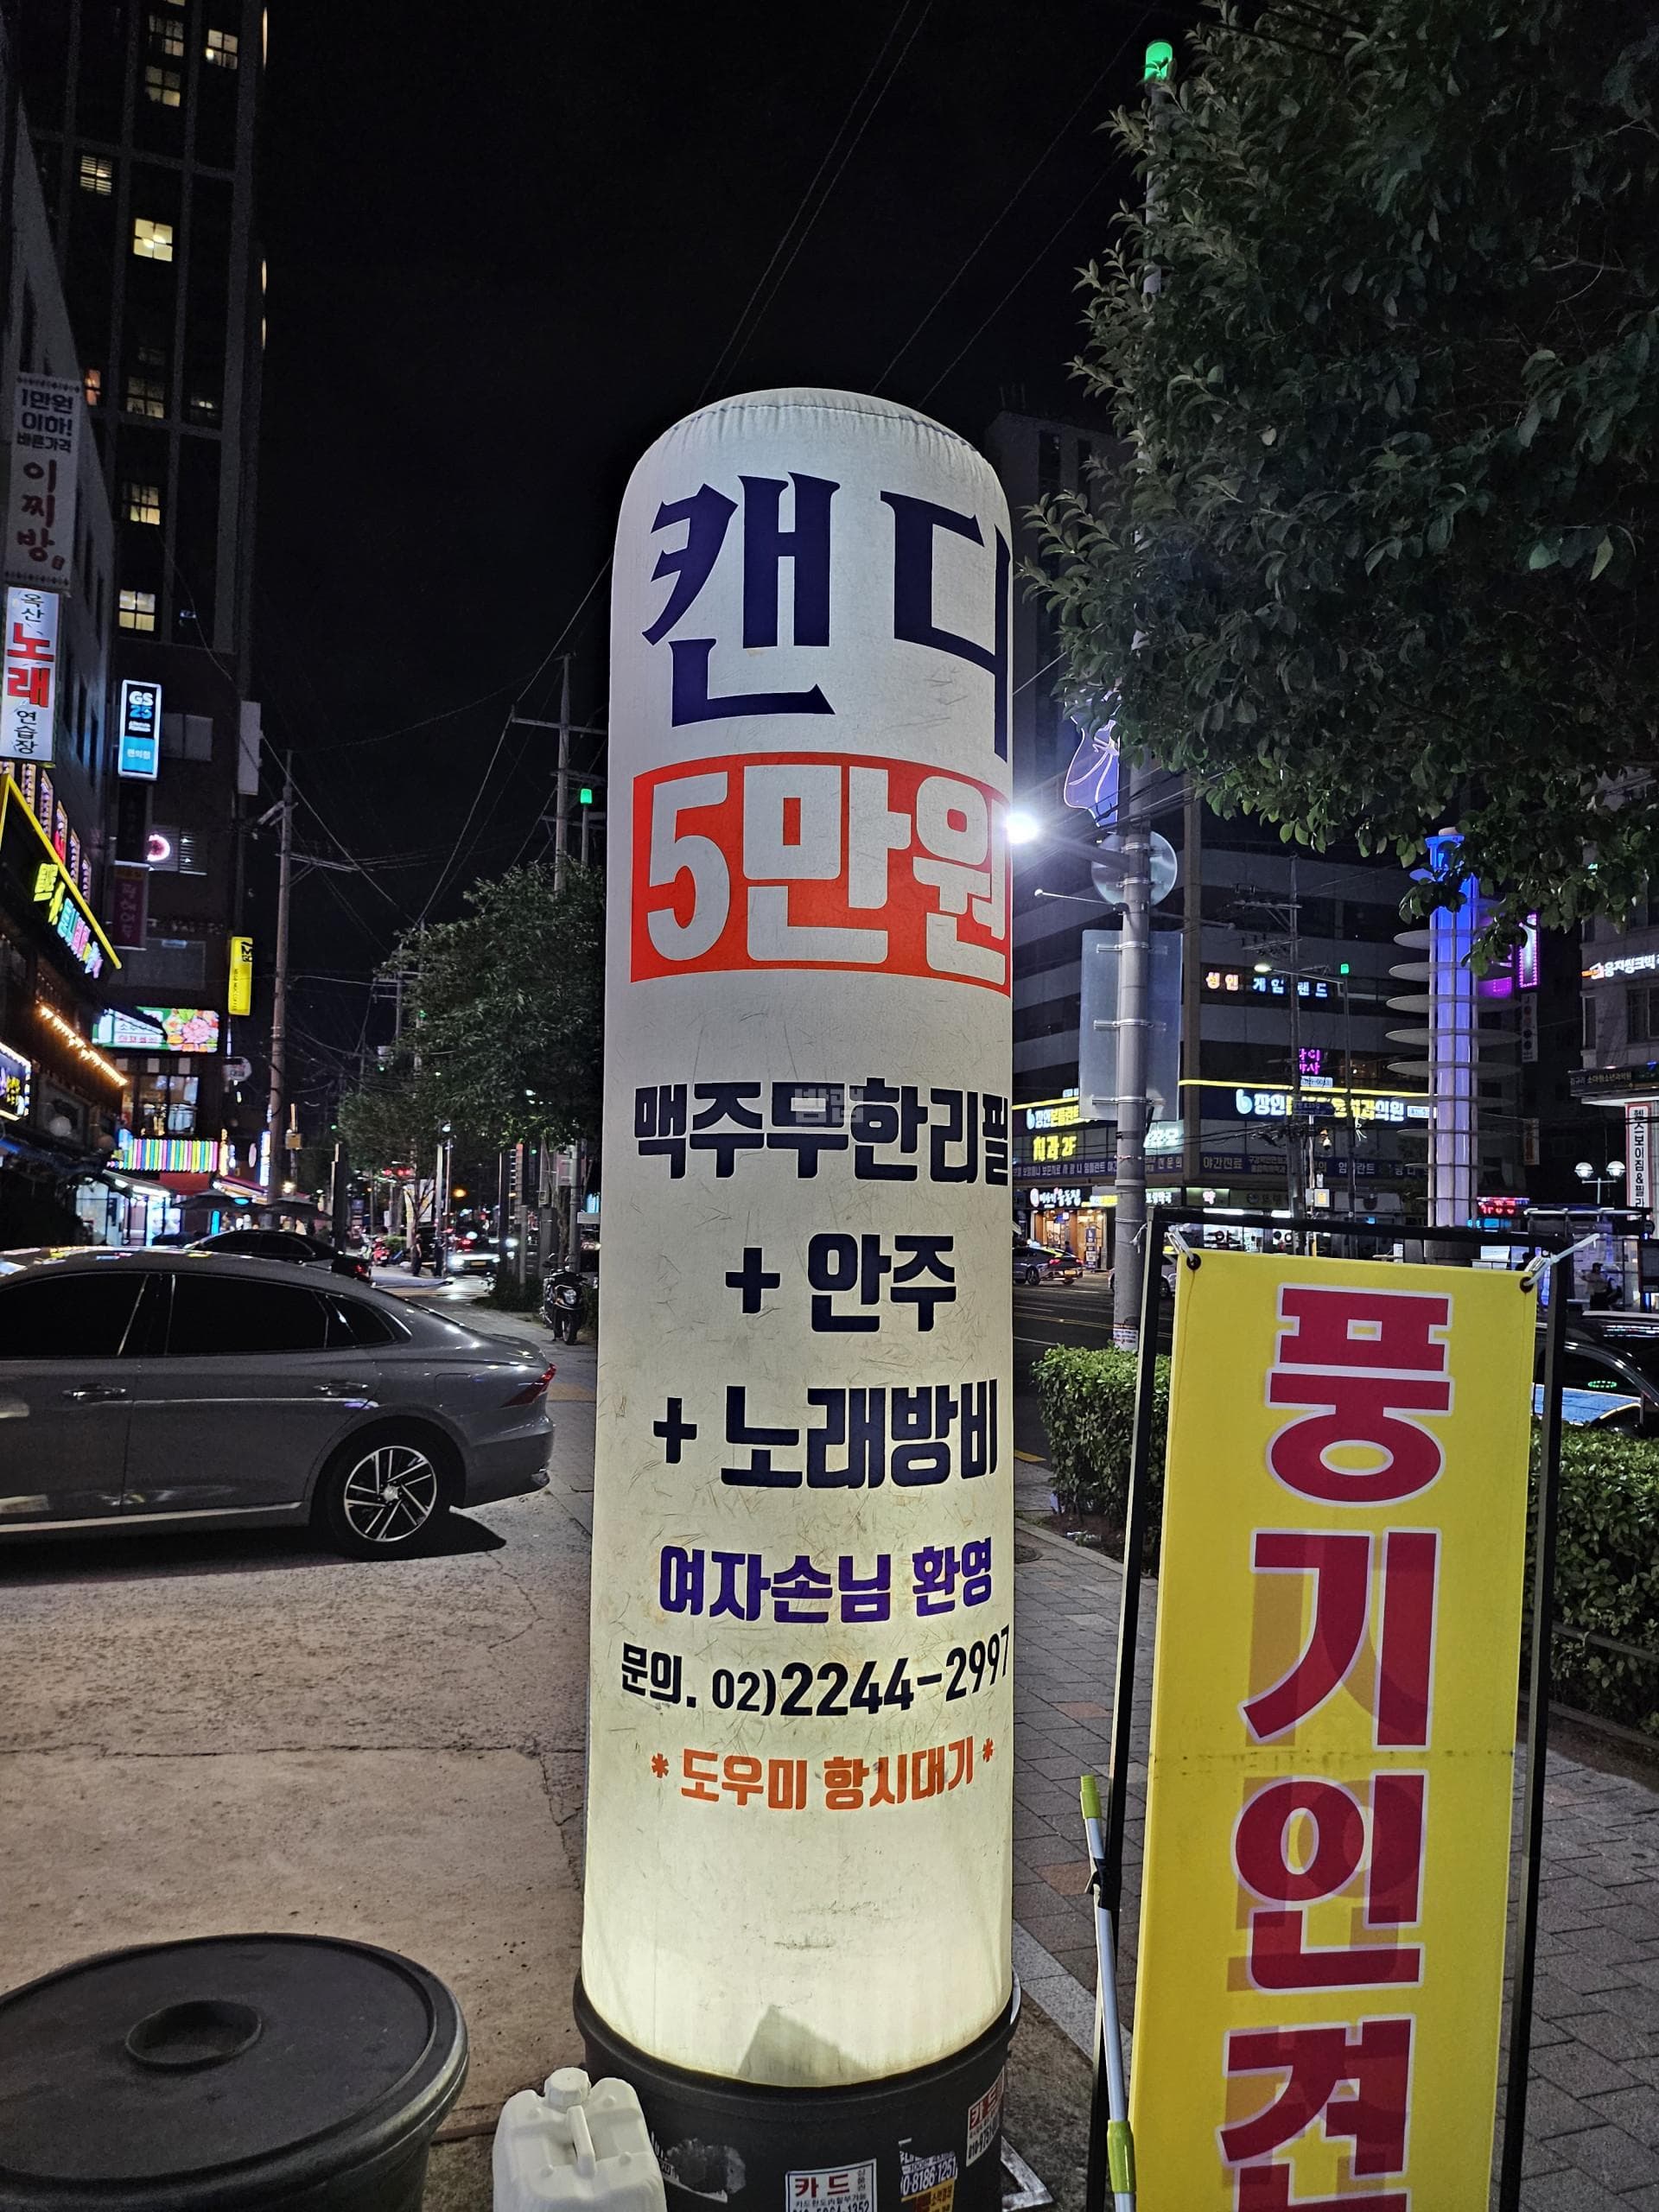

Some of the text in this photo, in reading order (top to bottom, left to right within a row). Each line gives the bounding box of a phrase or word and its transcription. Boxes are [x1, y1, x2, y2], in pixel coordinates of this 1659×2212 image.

[22, 389, 73, 414] 1만원
[22, 412, 73, 436] 이하!
[642, 472, 1011, 763] 캔디
[7, 623, 54, 708] 노래
[130, 691, 154, 706] GS
[130, 704, 153, 720] 25
[647, 765, 1006, 986] 5만원
[1205, 971, 1328, 998] 성인 게임 랜드
[634, 1077, 1008, 1186] 맥주무한리필
[1033, 1135, 1059, 1162] 치과
[1203, 1157, 1243, 1170] 야간진료
[1338, 1160, 1375, 1175] 임란트
[808, 1233, 957, 1332] 안주
[721, 1379, 998, 1489] 노래방비
[659, 1536, 992, 1624] 여자손님 환영
[712, 1624, 1009, 1716] 02)2244-2997
[681, 1736, 974, 1811] 도우미 항시대기
[1218, 1284, 1454, 2212] 풍기인견
[795, 2174, 850, 2198] 카드
